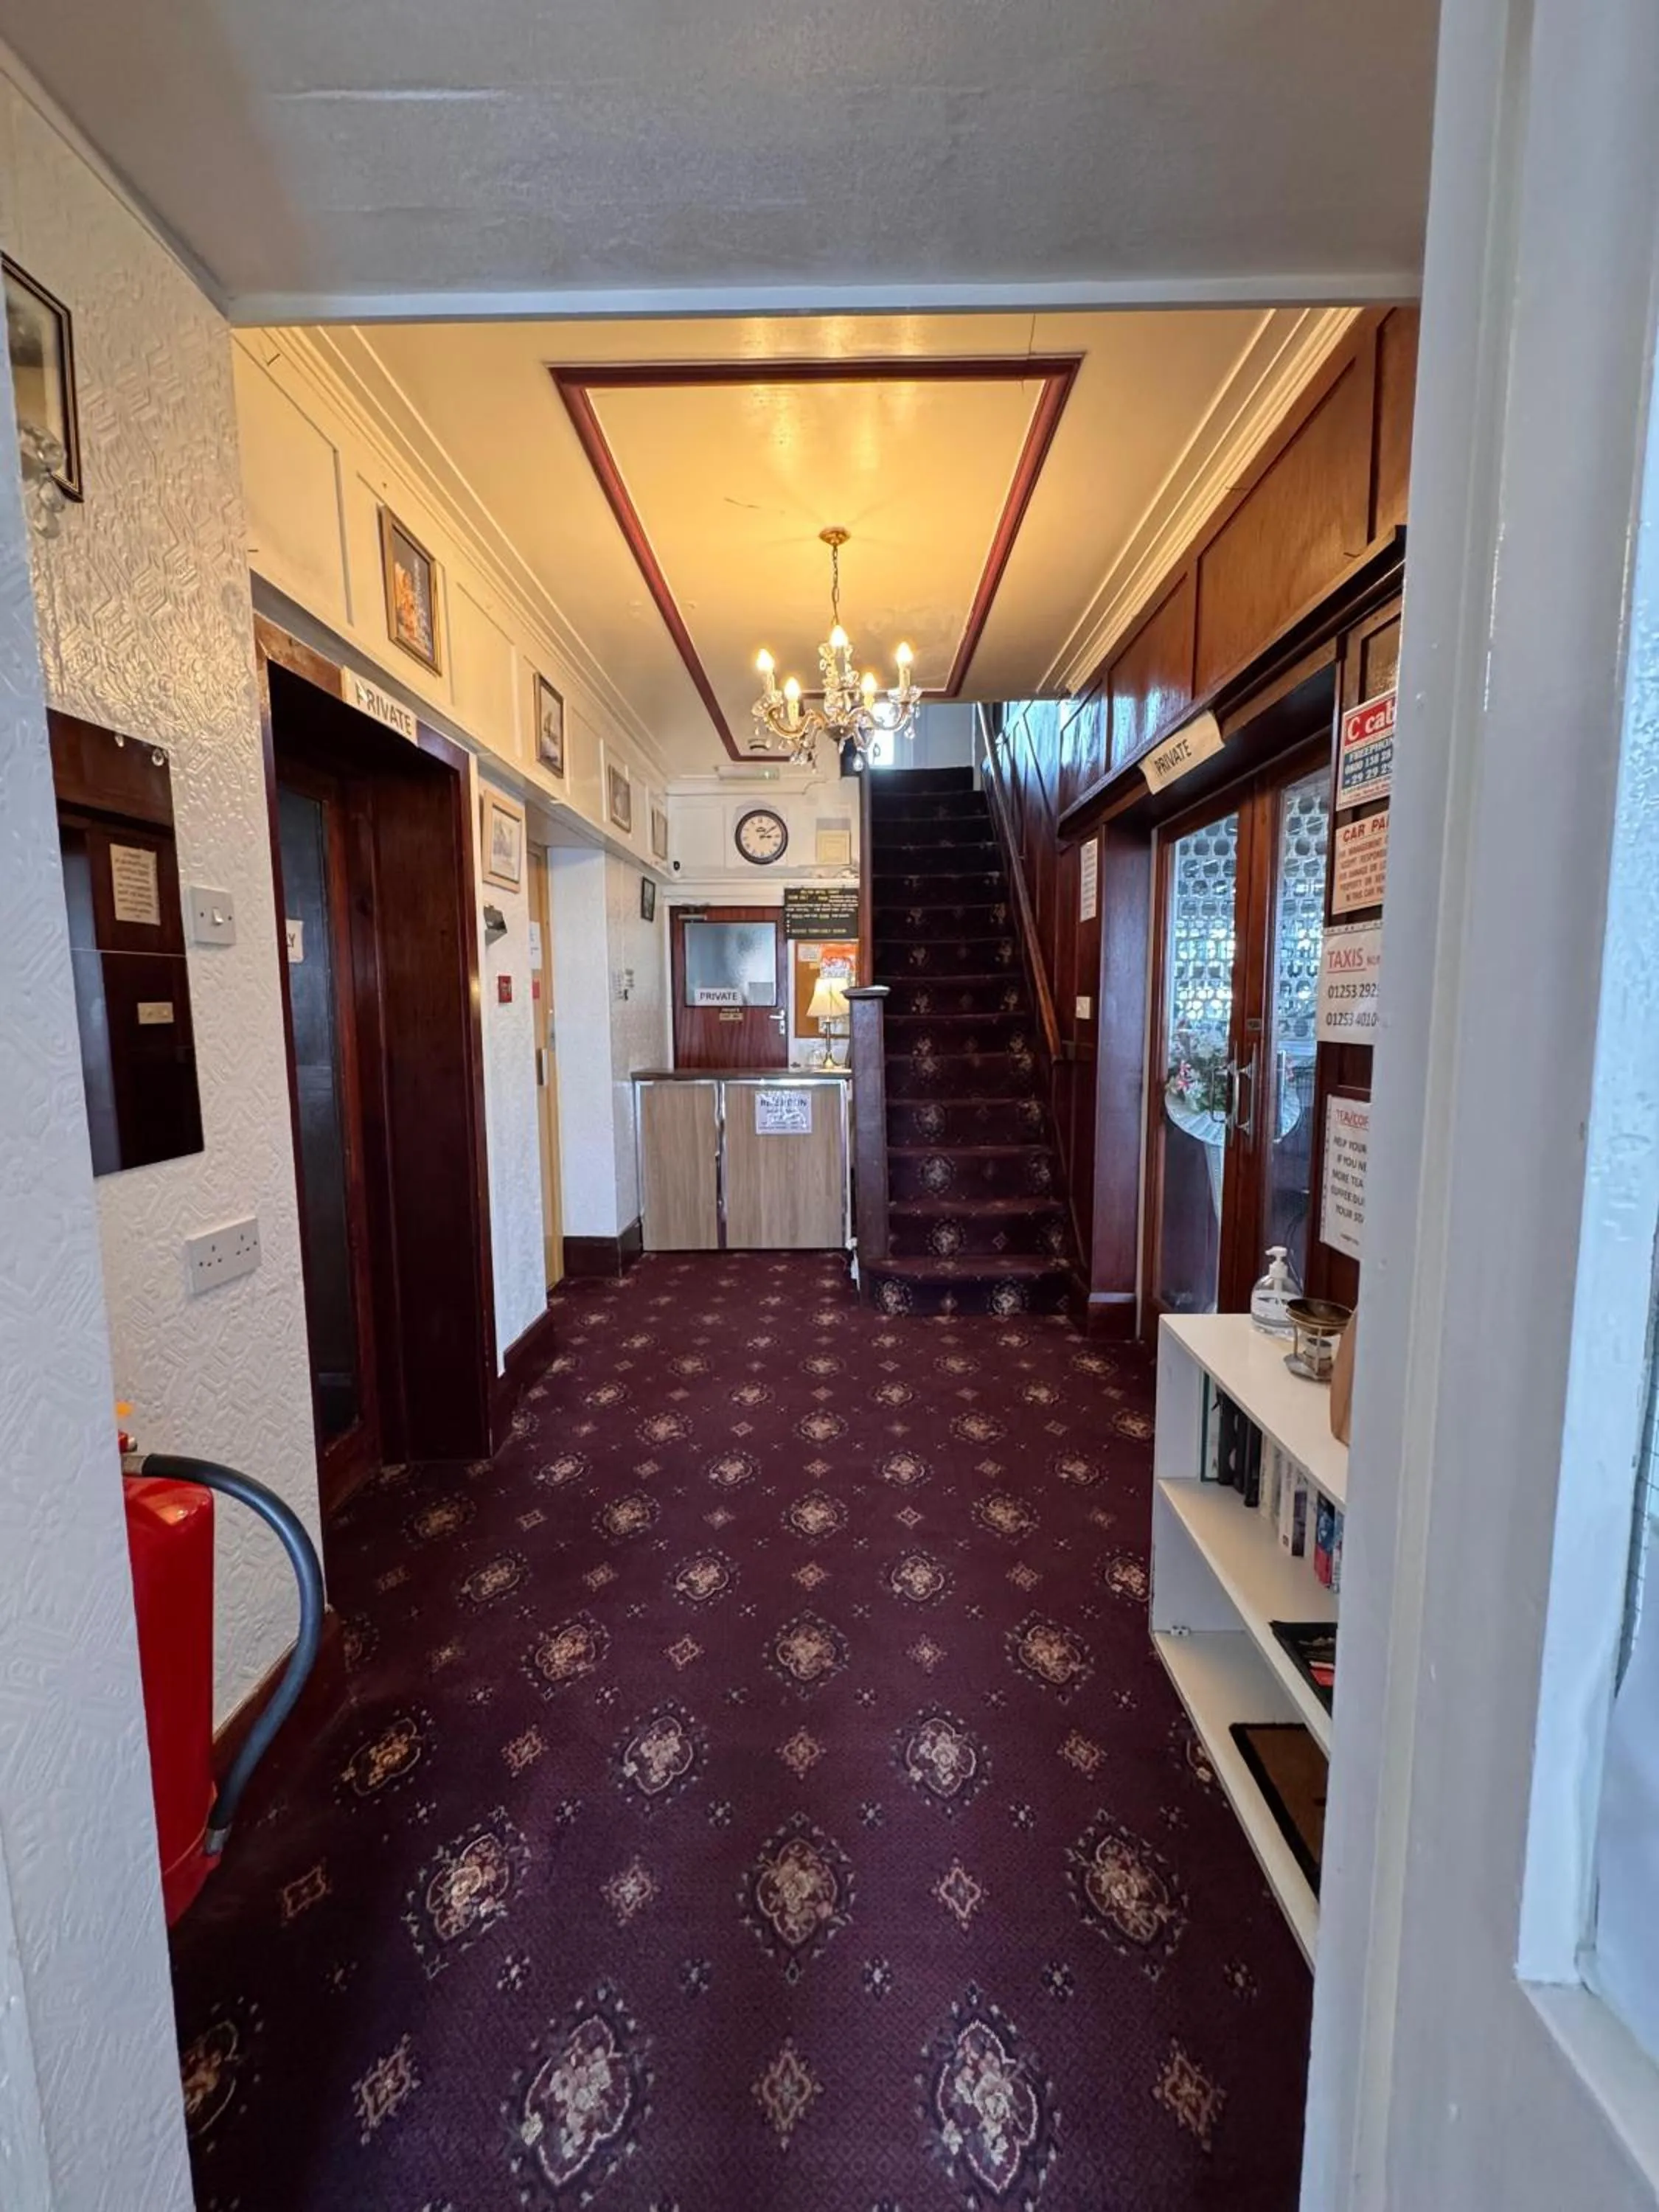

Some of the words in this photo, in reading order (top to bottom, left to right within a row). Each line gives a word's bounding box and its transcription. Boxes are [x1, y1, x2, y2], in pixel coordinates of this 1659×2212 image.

[355, 680, 412, 736] PRIVATE
[1347, 716, 1360, 741] C
[1154, 738, 1192, 776] PRIVATE
[1343, 824, 1366, 842] CAR
[1371, 814, 1389, 832] PA
[1328, 947, 1364, 969] TAXIS
[700, 992, 738, 1001] PRIVATE
[1328, 984, 1357, 999] 01253
[1326, 1012, 1354, 1026] 01253
[1338, 1153, 1343, 1164] IF
[1343, 1155, 1357, 1169] YOU
[1332, 1168, 1350, 1185] MORE
